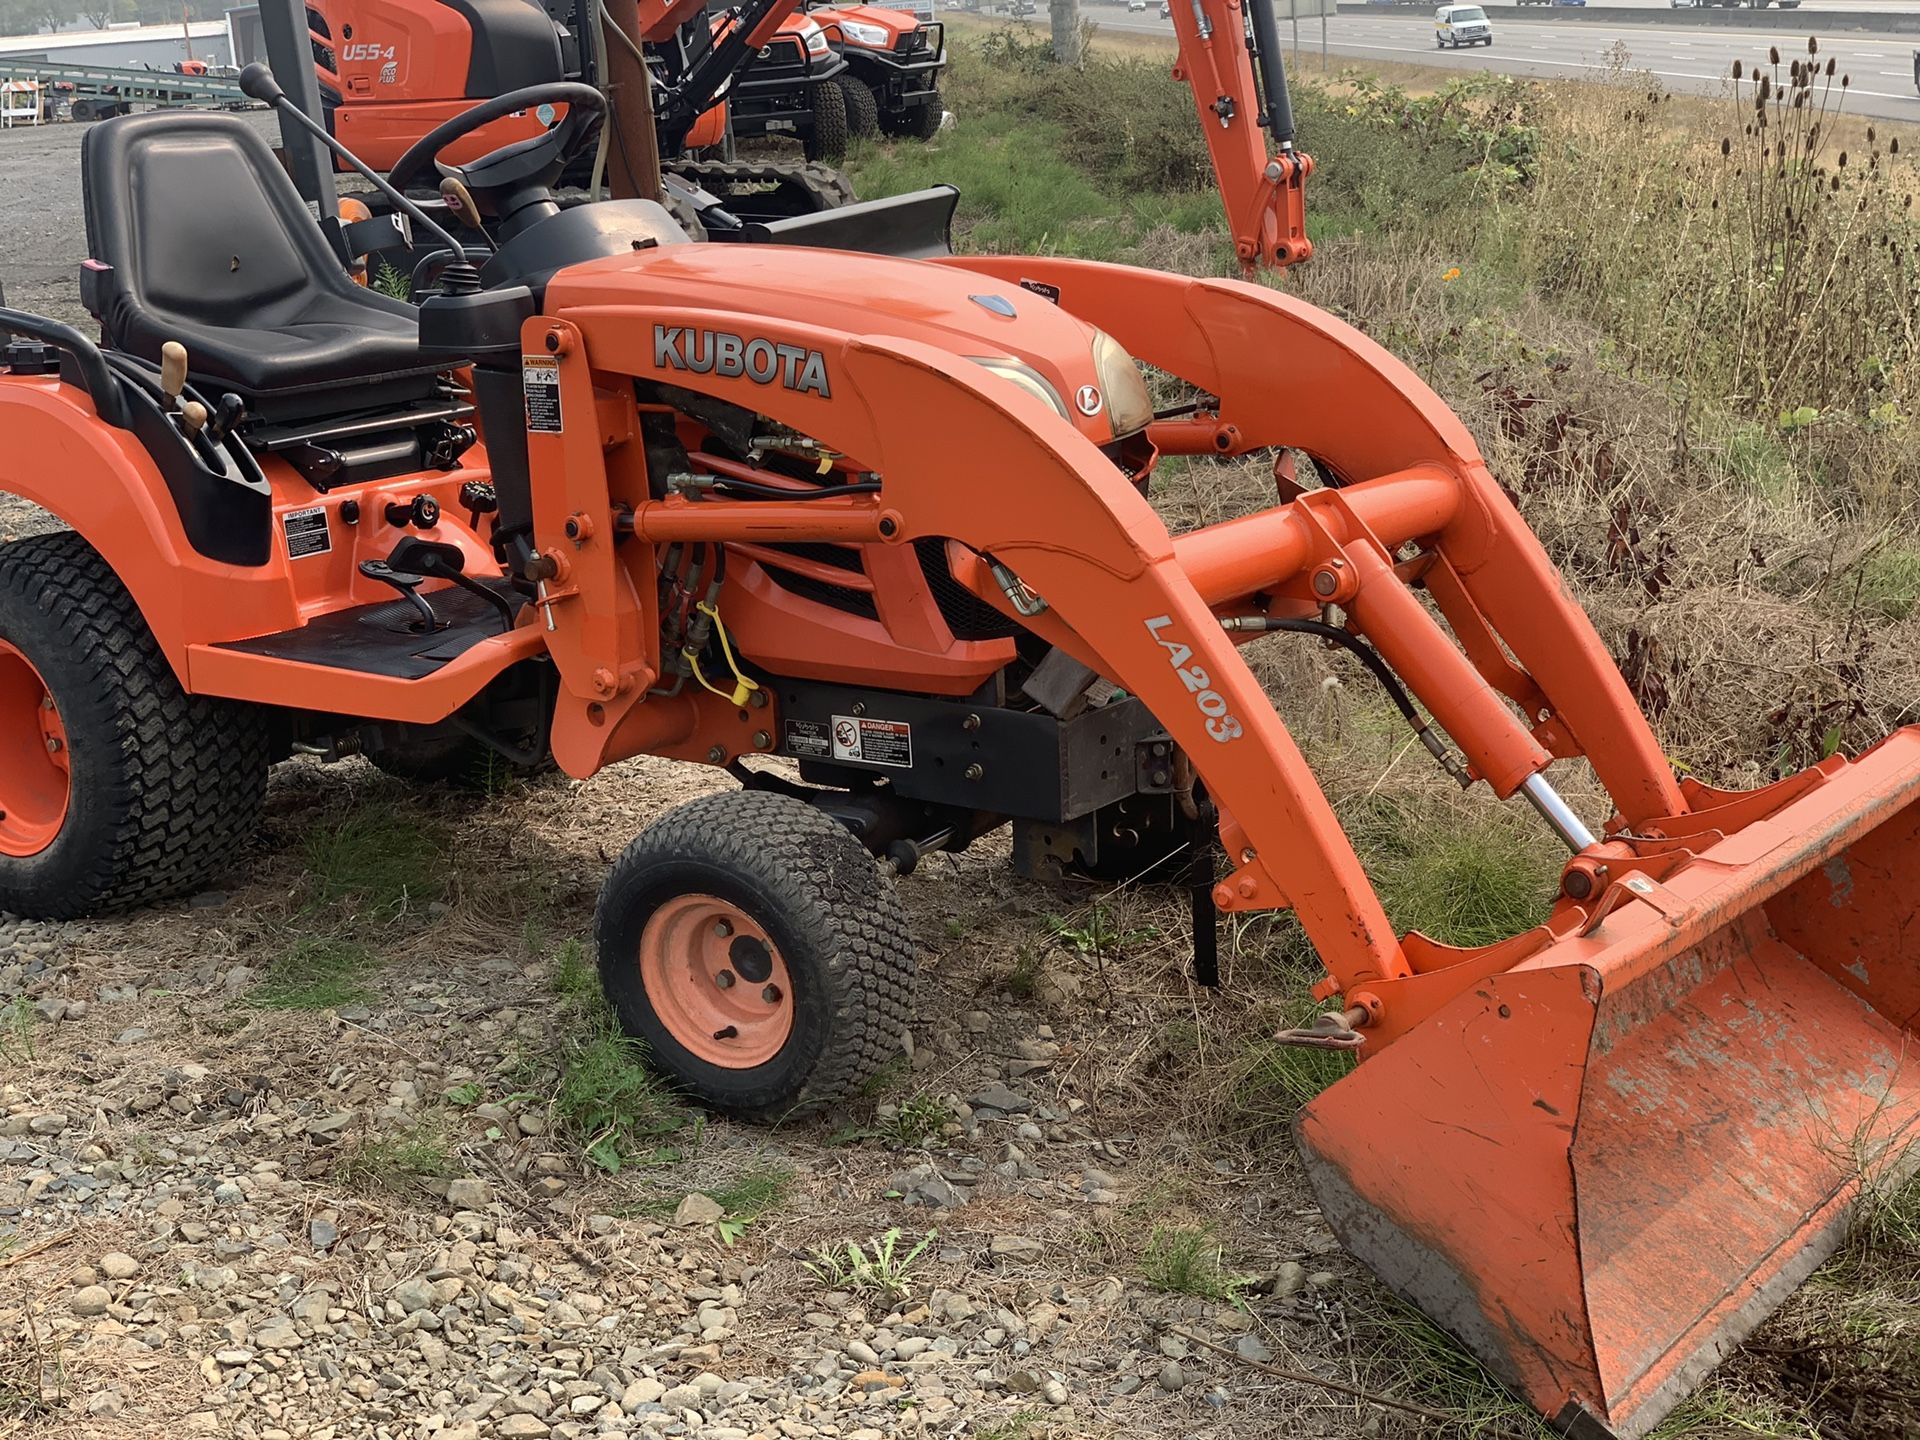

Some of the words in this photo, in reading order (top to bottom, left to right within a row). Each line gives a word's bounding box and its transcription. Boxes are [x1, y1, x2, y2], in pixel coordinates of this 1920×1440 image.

[342, 43, 396, 61] U55-4
[382, 67, 397, 76] eco
[652, 324, 831, 399] KUBOTA
[287, 507, 321, 519] IMPORTANT
[1143, 615, 1243, 743] LA203
[867, 722, 894, 731] DANGER
